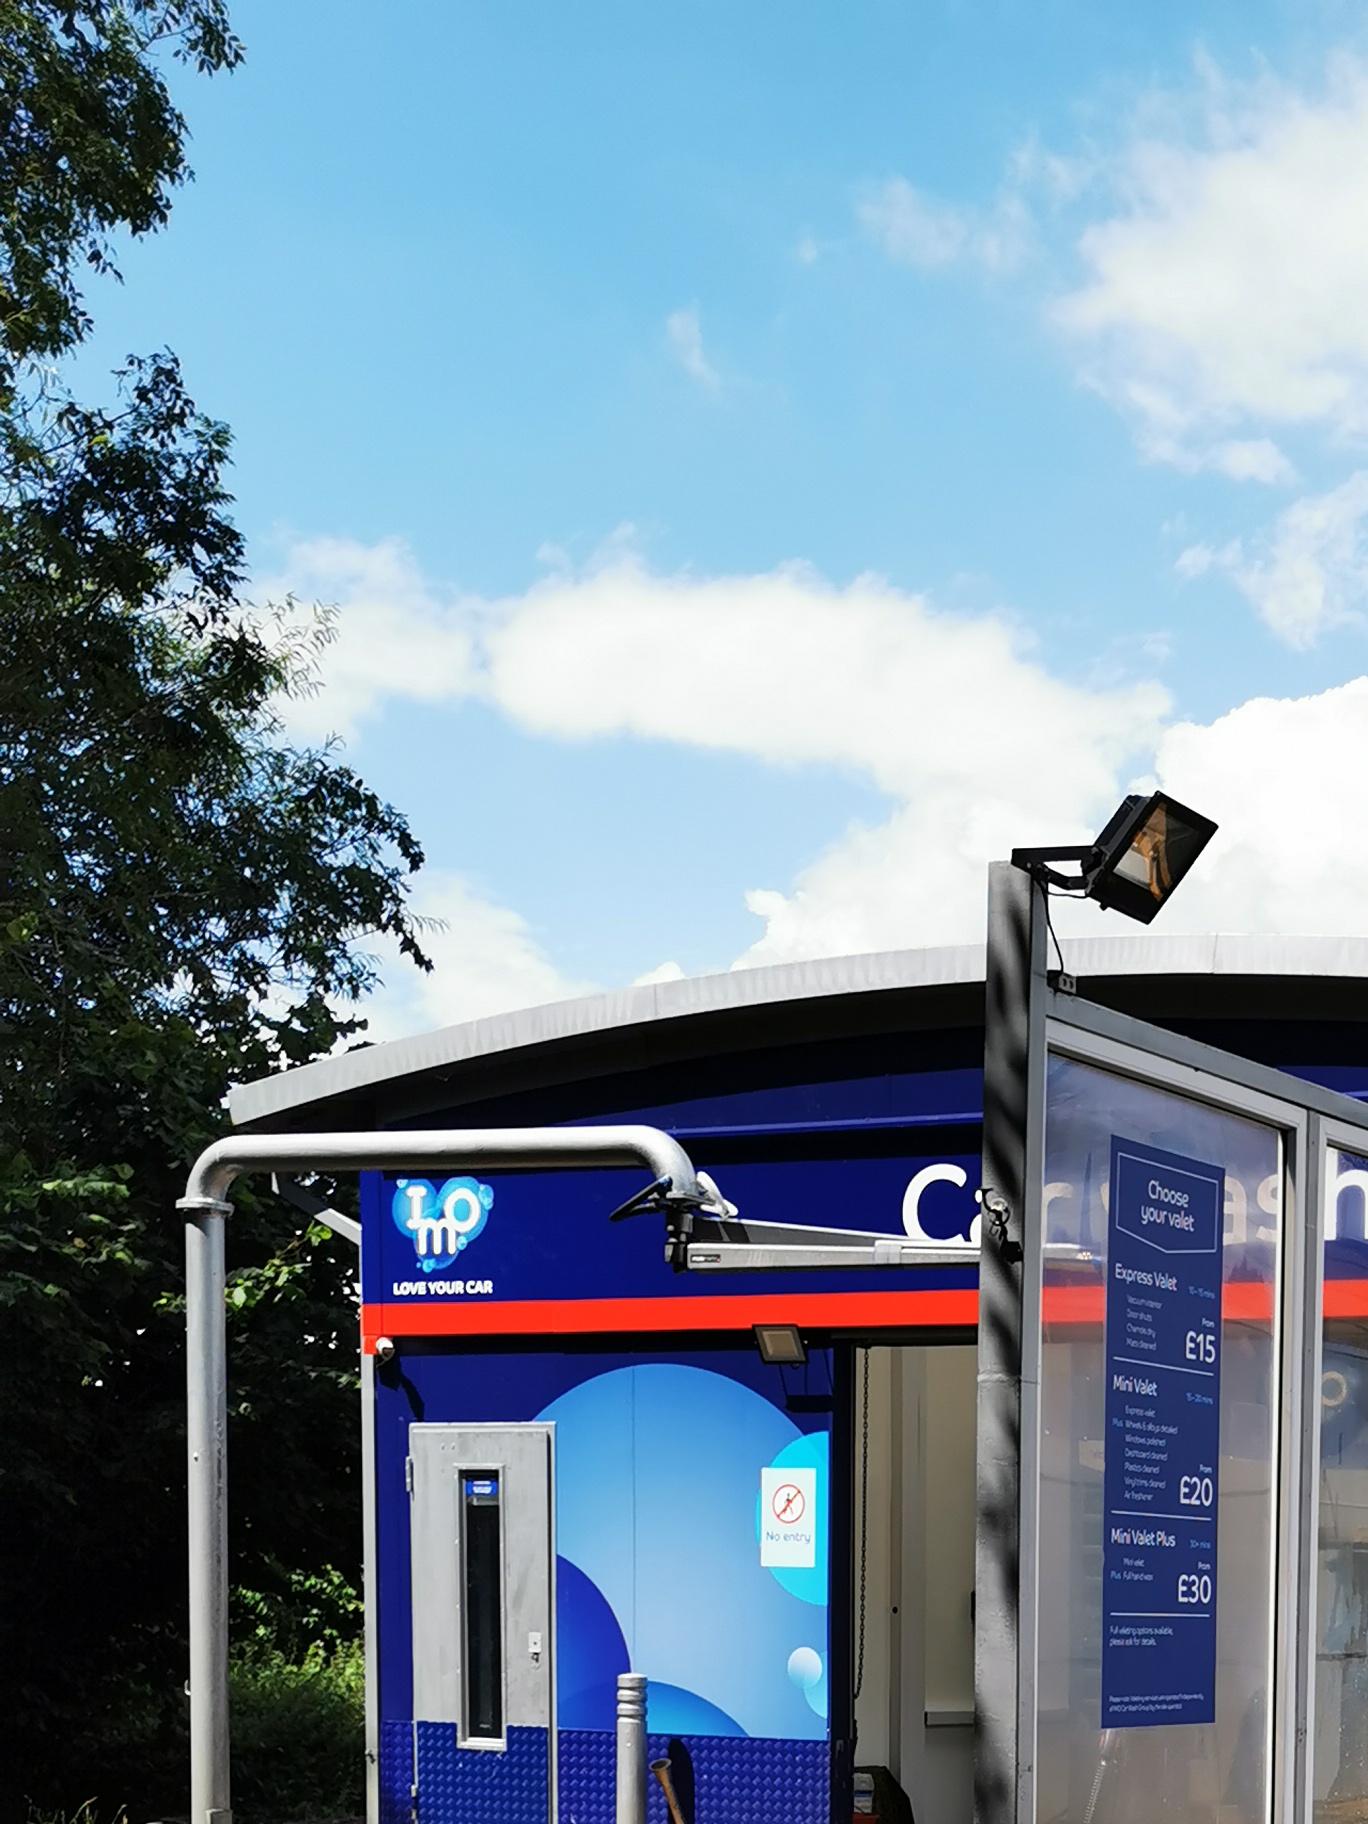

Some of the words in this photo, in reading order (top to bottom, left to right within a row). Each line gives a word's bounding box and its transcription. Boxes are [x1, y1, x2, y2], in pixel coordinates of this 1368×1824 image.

[1148, 1179, 1190, 1208] Choose
[1140, 1205, 1168, 1225] your
[1168, 1210, 1195, 1232] valet
[392, 1281, 427, 1296] LOVE
[428, 1280, 465, 1295] YOUR
[465, 1279, 494, 1294] CAR
[1115, 1262, 1153, 1286] Express
[1153, 1271, 1178, 1291] Valet
[1185, 1330, 1216, 1363] £15
[1113, 1374, 1133, 1392] Mini
[1133, 1378, 1158, 1397] Valet
[1199, 1463, 1212, 1474] From
[1180, 1475, 1213, 1506] £20
[766, 1531, 780, 1541] No
[783, 1533, 811, 1545] entry
[1111, 1528, 1131, 1545] Mini
[1131, 1528, 1155, 1546] Valet
[1156, 1530, 1176, 1547] Plus
[1197, 1561, 1211, 1570] From
[1178, 1574, 1212, 1604] £30
